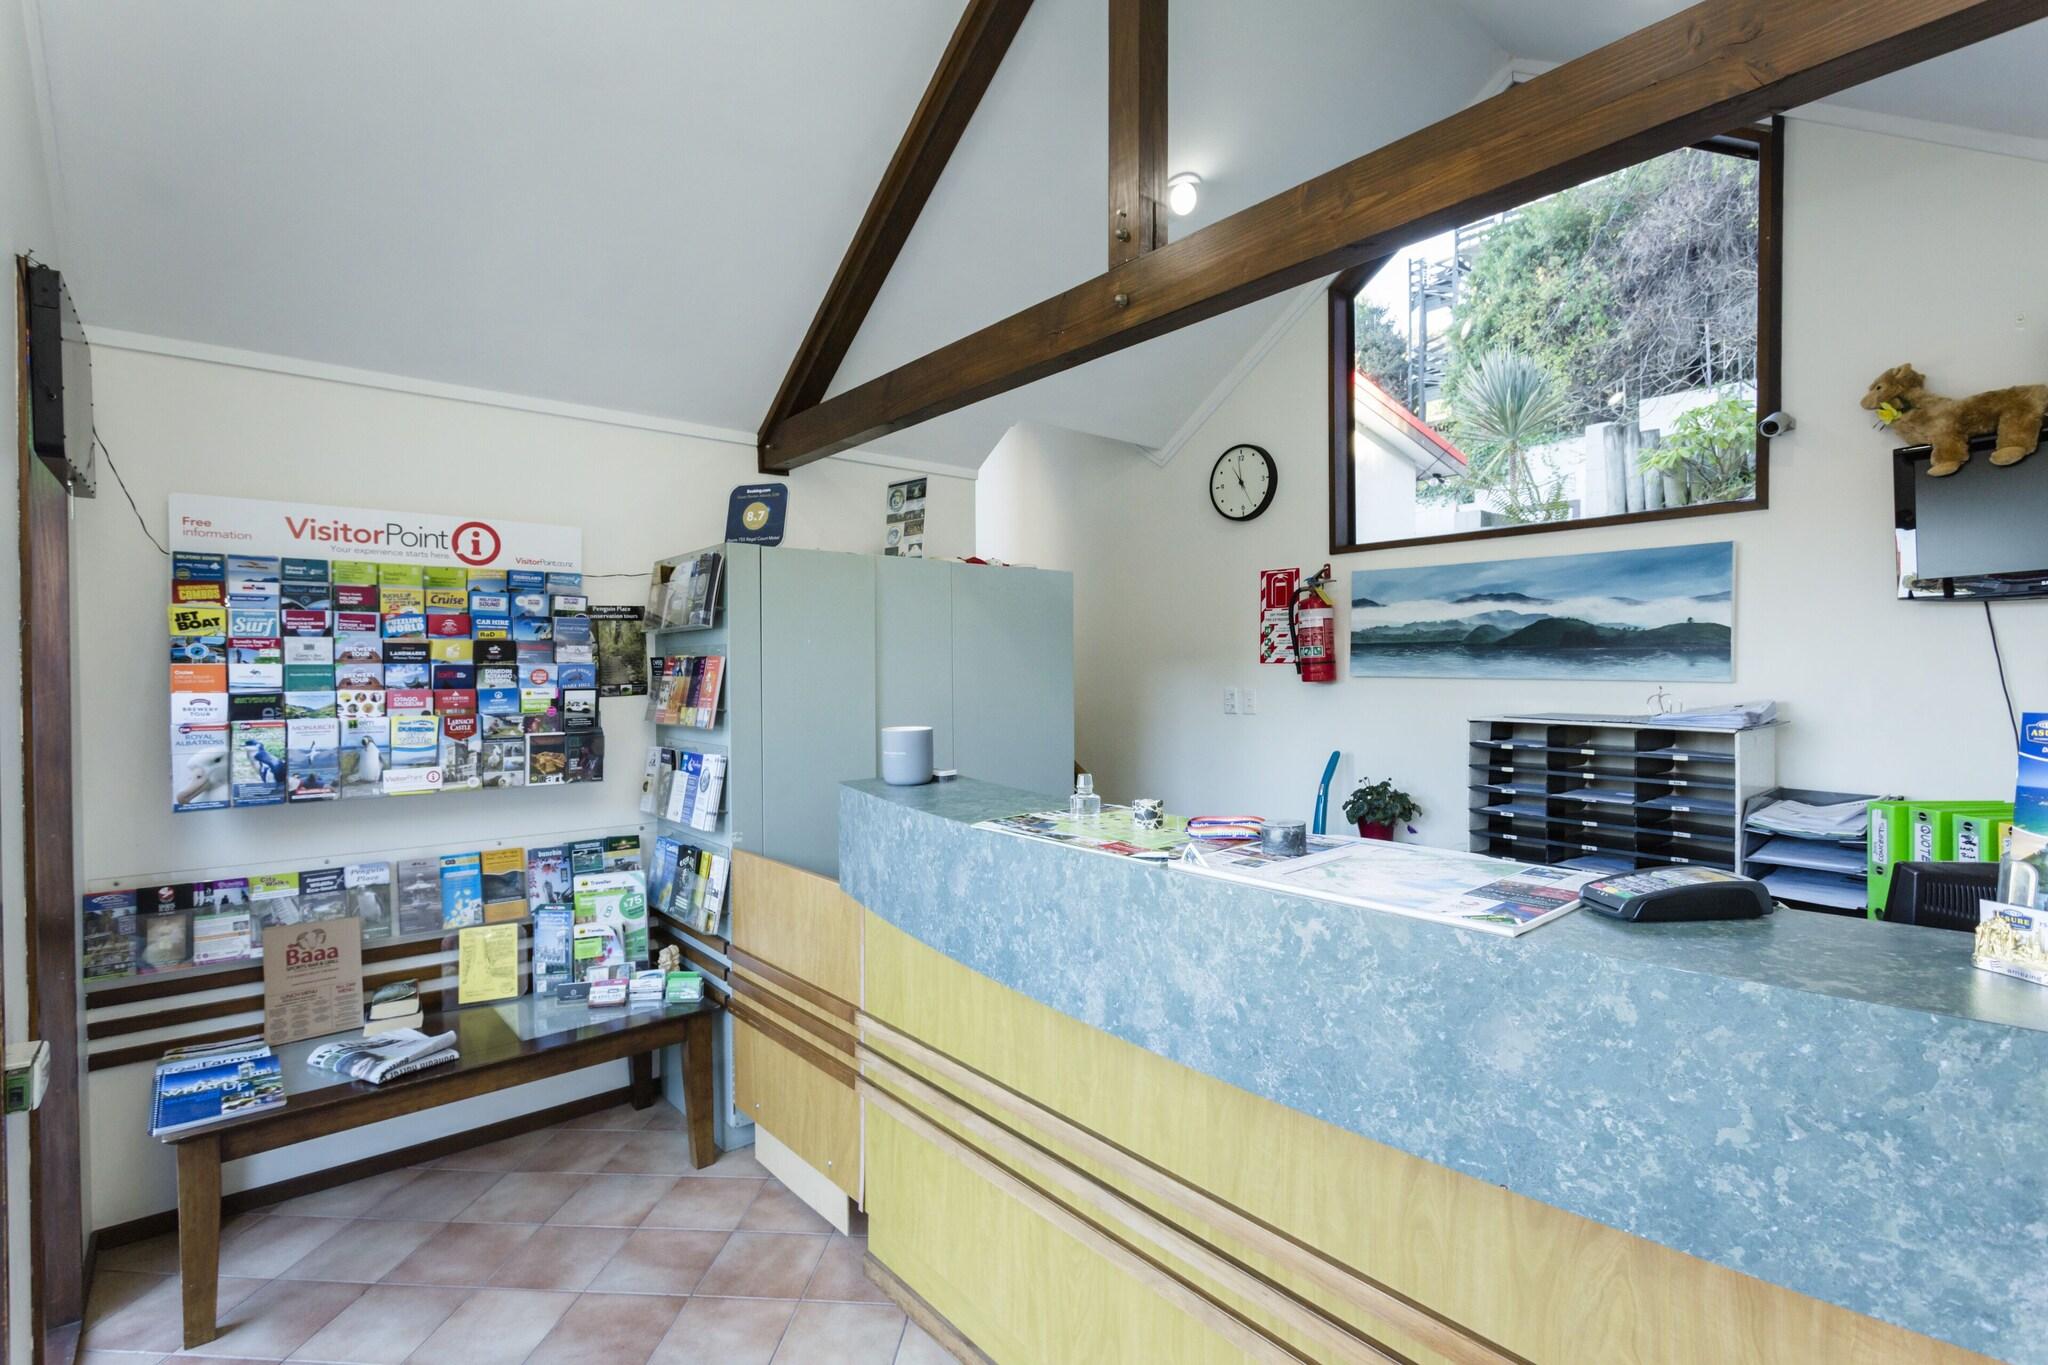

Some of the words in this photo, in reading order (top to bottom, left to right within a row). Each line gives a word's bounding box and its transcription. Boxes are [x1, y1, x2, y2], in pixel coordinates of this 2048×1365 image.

[182, 515, 212, 528] Free
[746, 510, 766, 522] 8.7
[183, 527, 253, 541] information
[285, 515, 449, 550] VisitorPoint
[330, 544, 351, 554] Your
[354, 547, 404, 558] experience
[405, 549, 429, 559] starts
[179, 590, 221, 601] COMBOS
[430, 594, 465, 605] Cruise
[174, 611, 198, 622] JET
[387, 617, 423, 627] PUZZLING
[176, 617, 221, 631] BOAT
[233, 617, 276, 637] Surf
[388, 623, 425, 633] WORLD
[447, 718, 474, 726] LARNACH
[185, 733, 214, 741] ROYAL
[350, 867, 385, 876] Penguin
[286, 946, 339, 966] Baaa
[201, 1053, 265, 1068] Farmer
